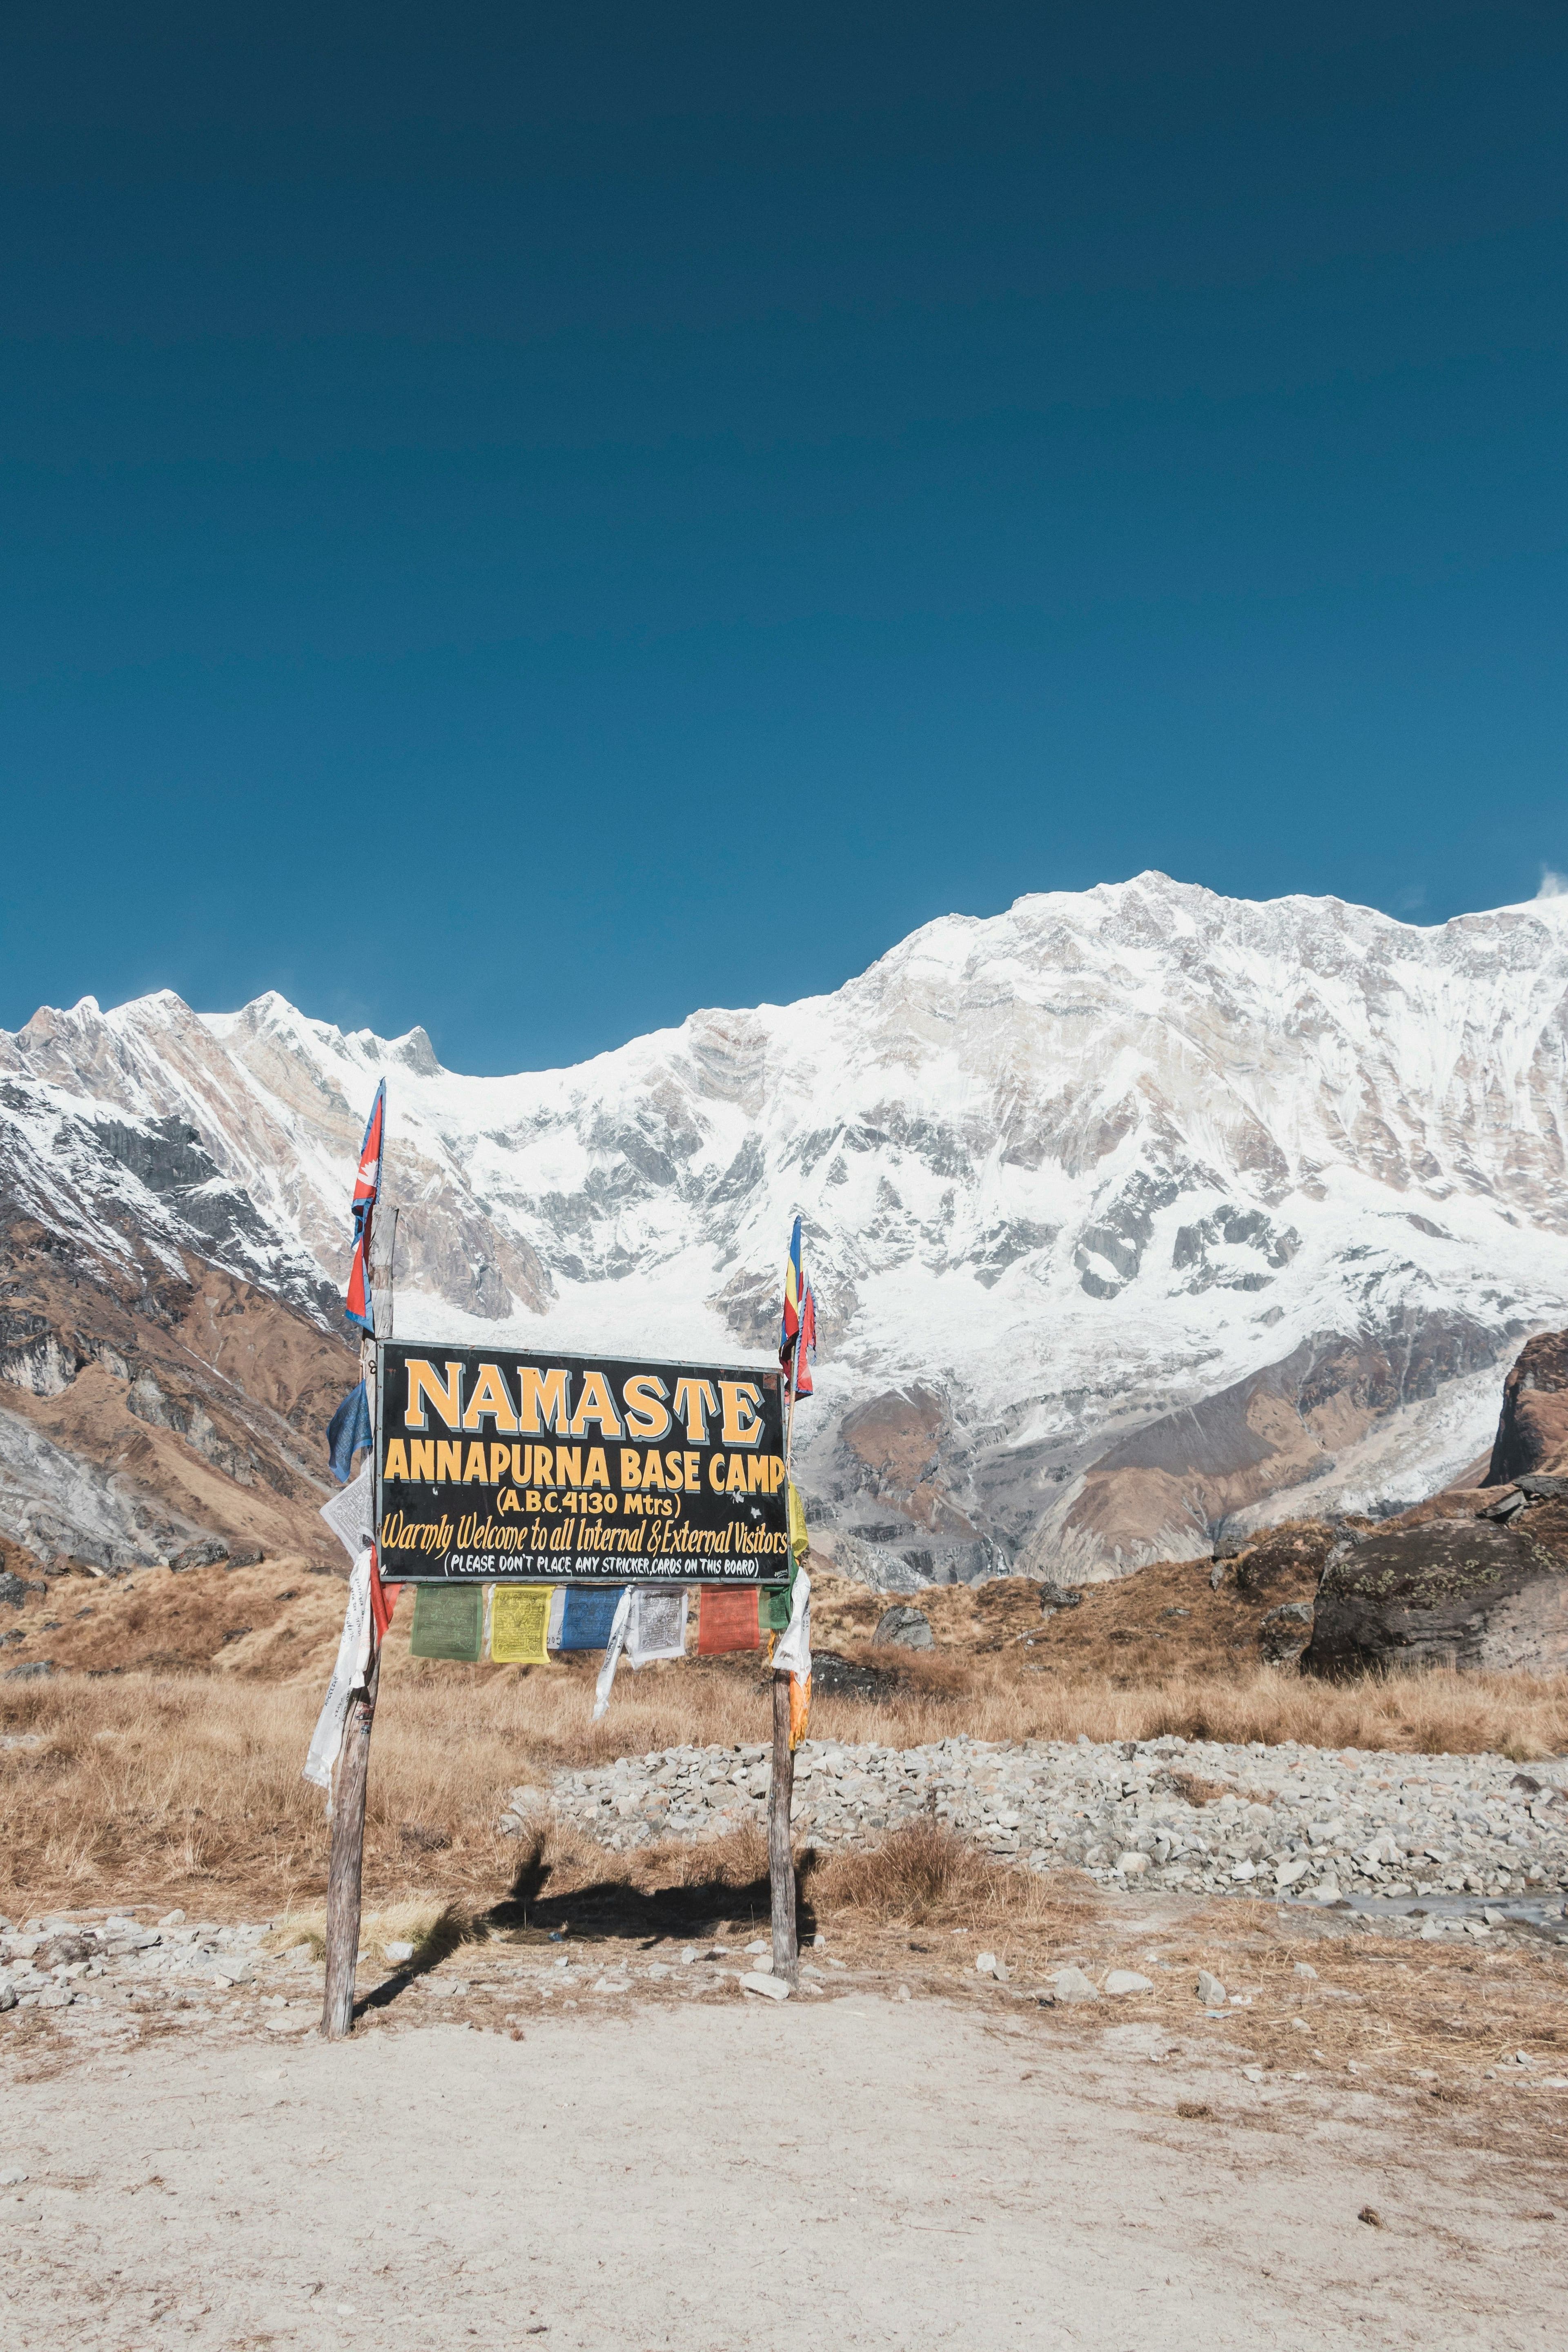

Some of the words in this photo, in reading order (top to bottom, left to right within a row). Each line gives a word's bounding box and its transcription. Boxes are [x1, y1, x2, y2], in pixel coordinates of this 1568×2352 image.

[404, 1359, 765, 1448] NAMASTE
[384, 1439, 610, 1490] ANNAPURNA
[621, 1448, 700, 1494] BASE
[709, 1453, 786, 1496] CAMP
[624, 1493, 681, 1518] Mtrs)
[381, 1510, 454, 1559] Warmly
[457, 1512, 528, 1554] Welcome
[531, 1517, 548, 1550] to
[550, 1517, 575, 1550] all
[577, 1518, 646, 1553] Internal
[735, 1521, 788, 1554] Visitors
[444, 1552, 496, 1576] (PLEASE
[499, 1553, 534, 1572] DON'T
[537, 1556, 572, 1575] PLACE
[575, 1557, 599, 1573] ANY
[684, 1558, 698, 1574] ON
[699, 1558, 721, 1574] THIS
[725, 1558, 759, 1577] BOARD)
